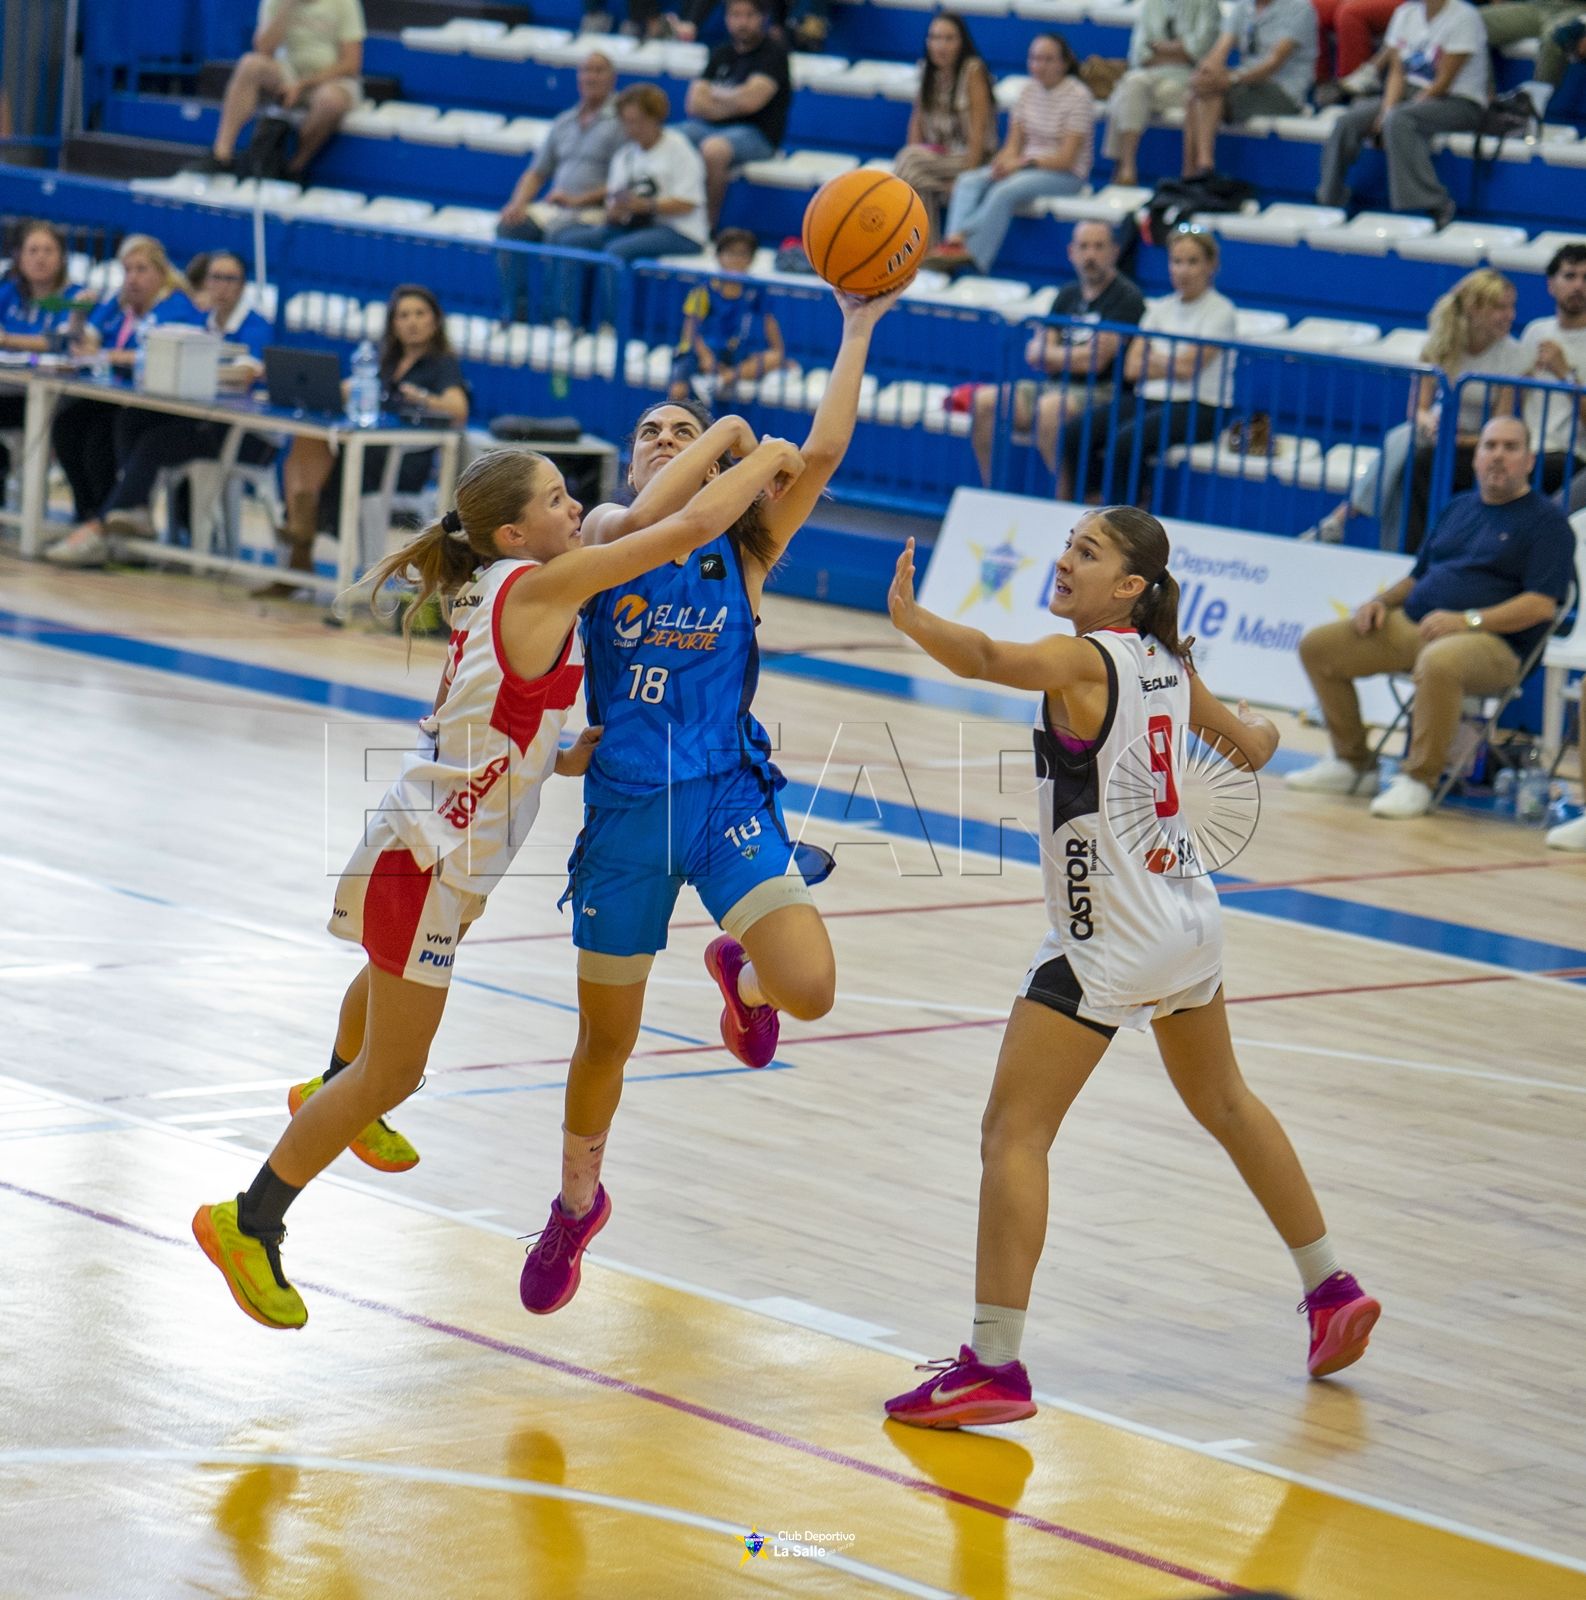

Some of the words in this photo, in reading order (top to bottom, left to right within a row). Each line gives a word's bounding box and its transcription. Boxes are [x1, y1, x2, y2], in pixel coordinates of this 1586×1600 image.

[643, 629, 719, 651] DEPORTE
[1233, 613, 1304, 652] Melill
[628, 663, 669, 704] 18
[1148, 714, 1179, 819] 9
[1065, 838, 1095, 941] CASTOR
